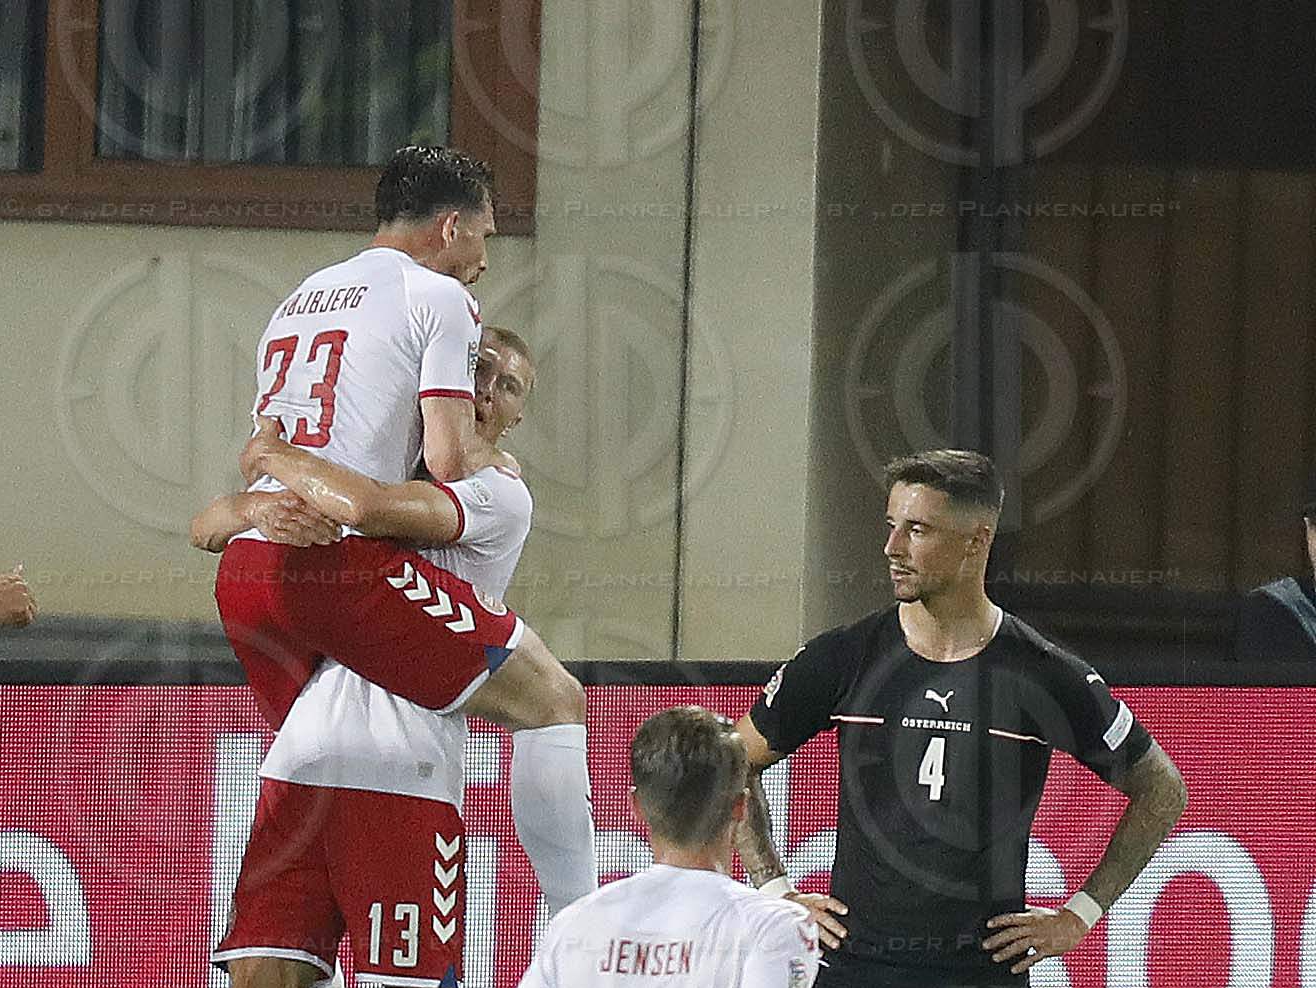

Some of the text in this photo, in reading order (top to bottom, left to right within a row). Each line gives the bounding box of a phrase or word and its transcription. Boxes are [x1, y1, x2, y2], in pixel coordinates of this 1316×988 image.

[257, 330, 349, 449] 23
[901, 716, 972, 733] ÖSTERREICH
[918, 736, 947, 801] 4
[368, 902, 420, 968] 13
[600, 938, 693, 976] JENSEN
